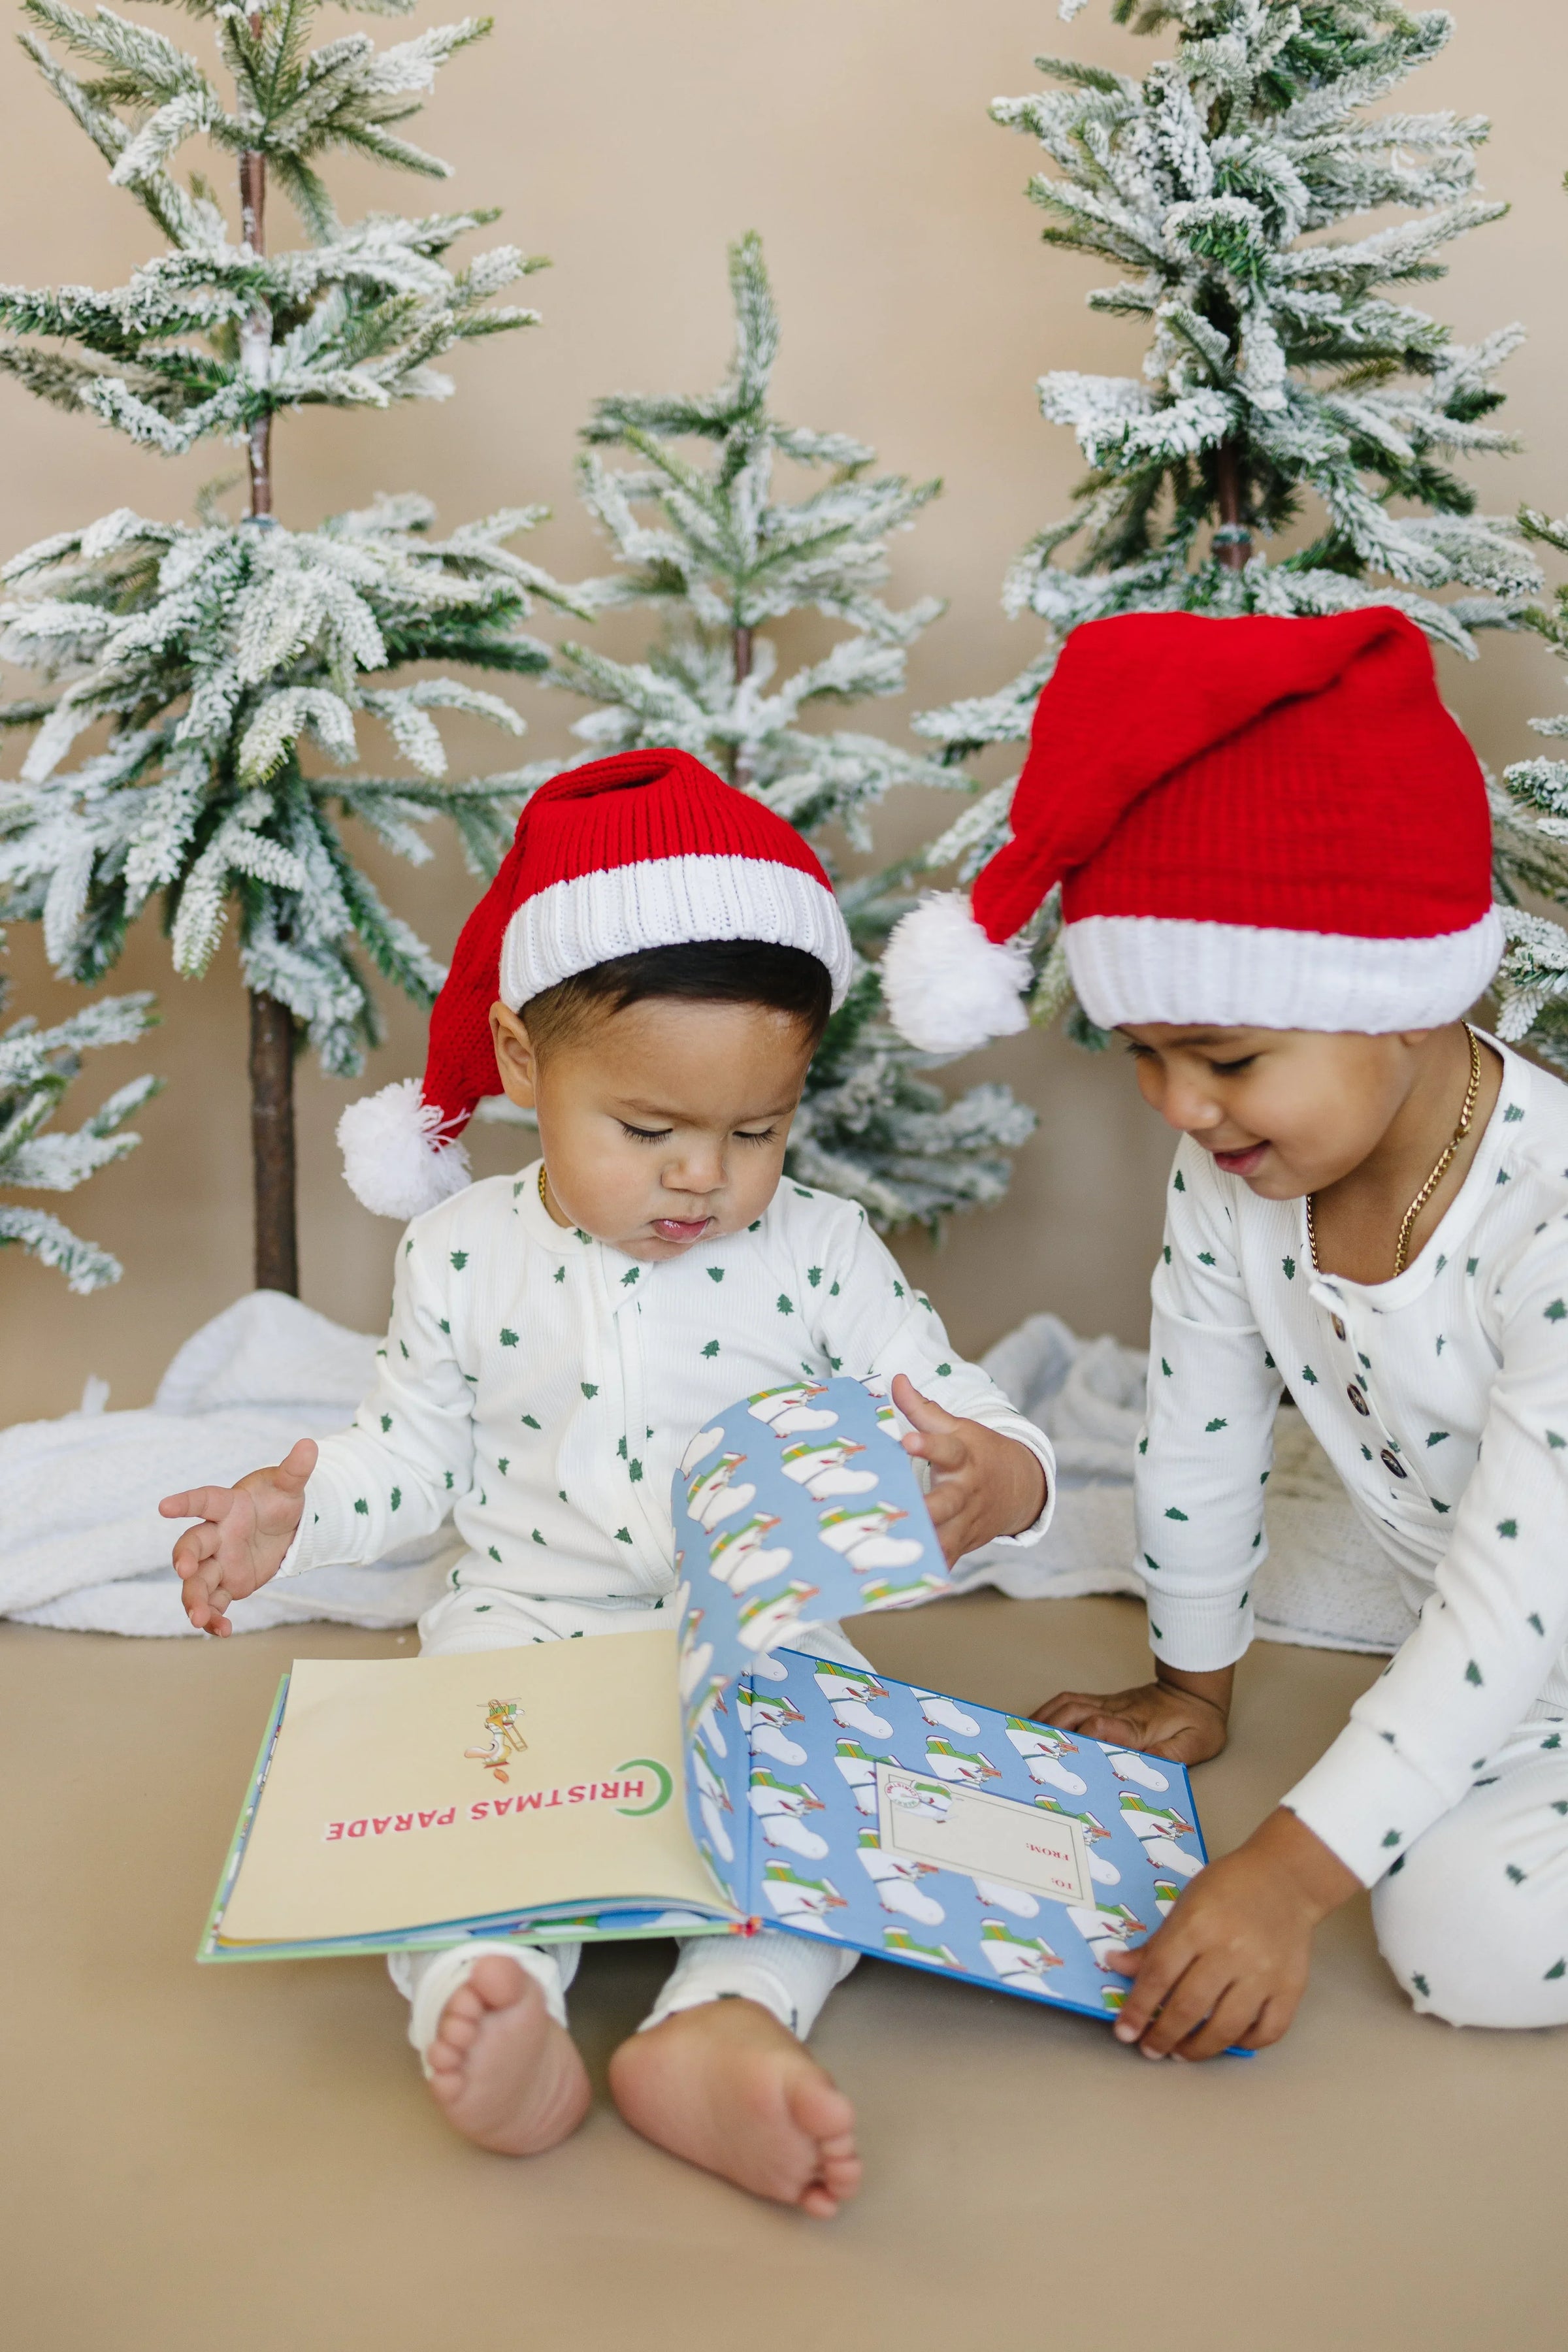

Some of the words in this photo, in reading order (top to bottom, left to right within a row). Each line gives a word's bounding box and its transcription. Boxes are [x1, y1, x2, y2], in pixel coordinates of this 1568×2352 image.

[470, 1758, 673, 1820] CHRISTMAS
[326, 1806, 456, 1841] PARADE
[1026, 1842, 1069, 1861] FROM:
[1051, 1878, 1072, 1890] TO:
